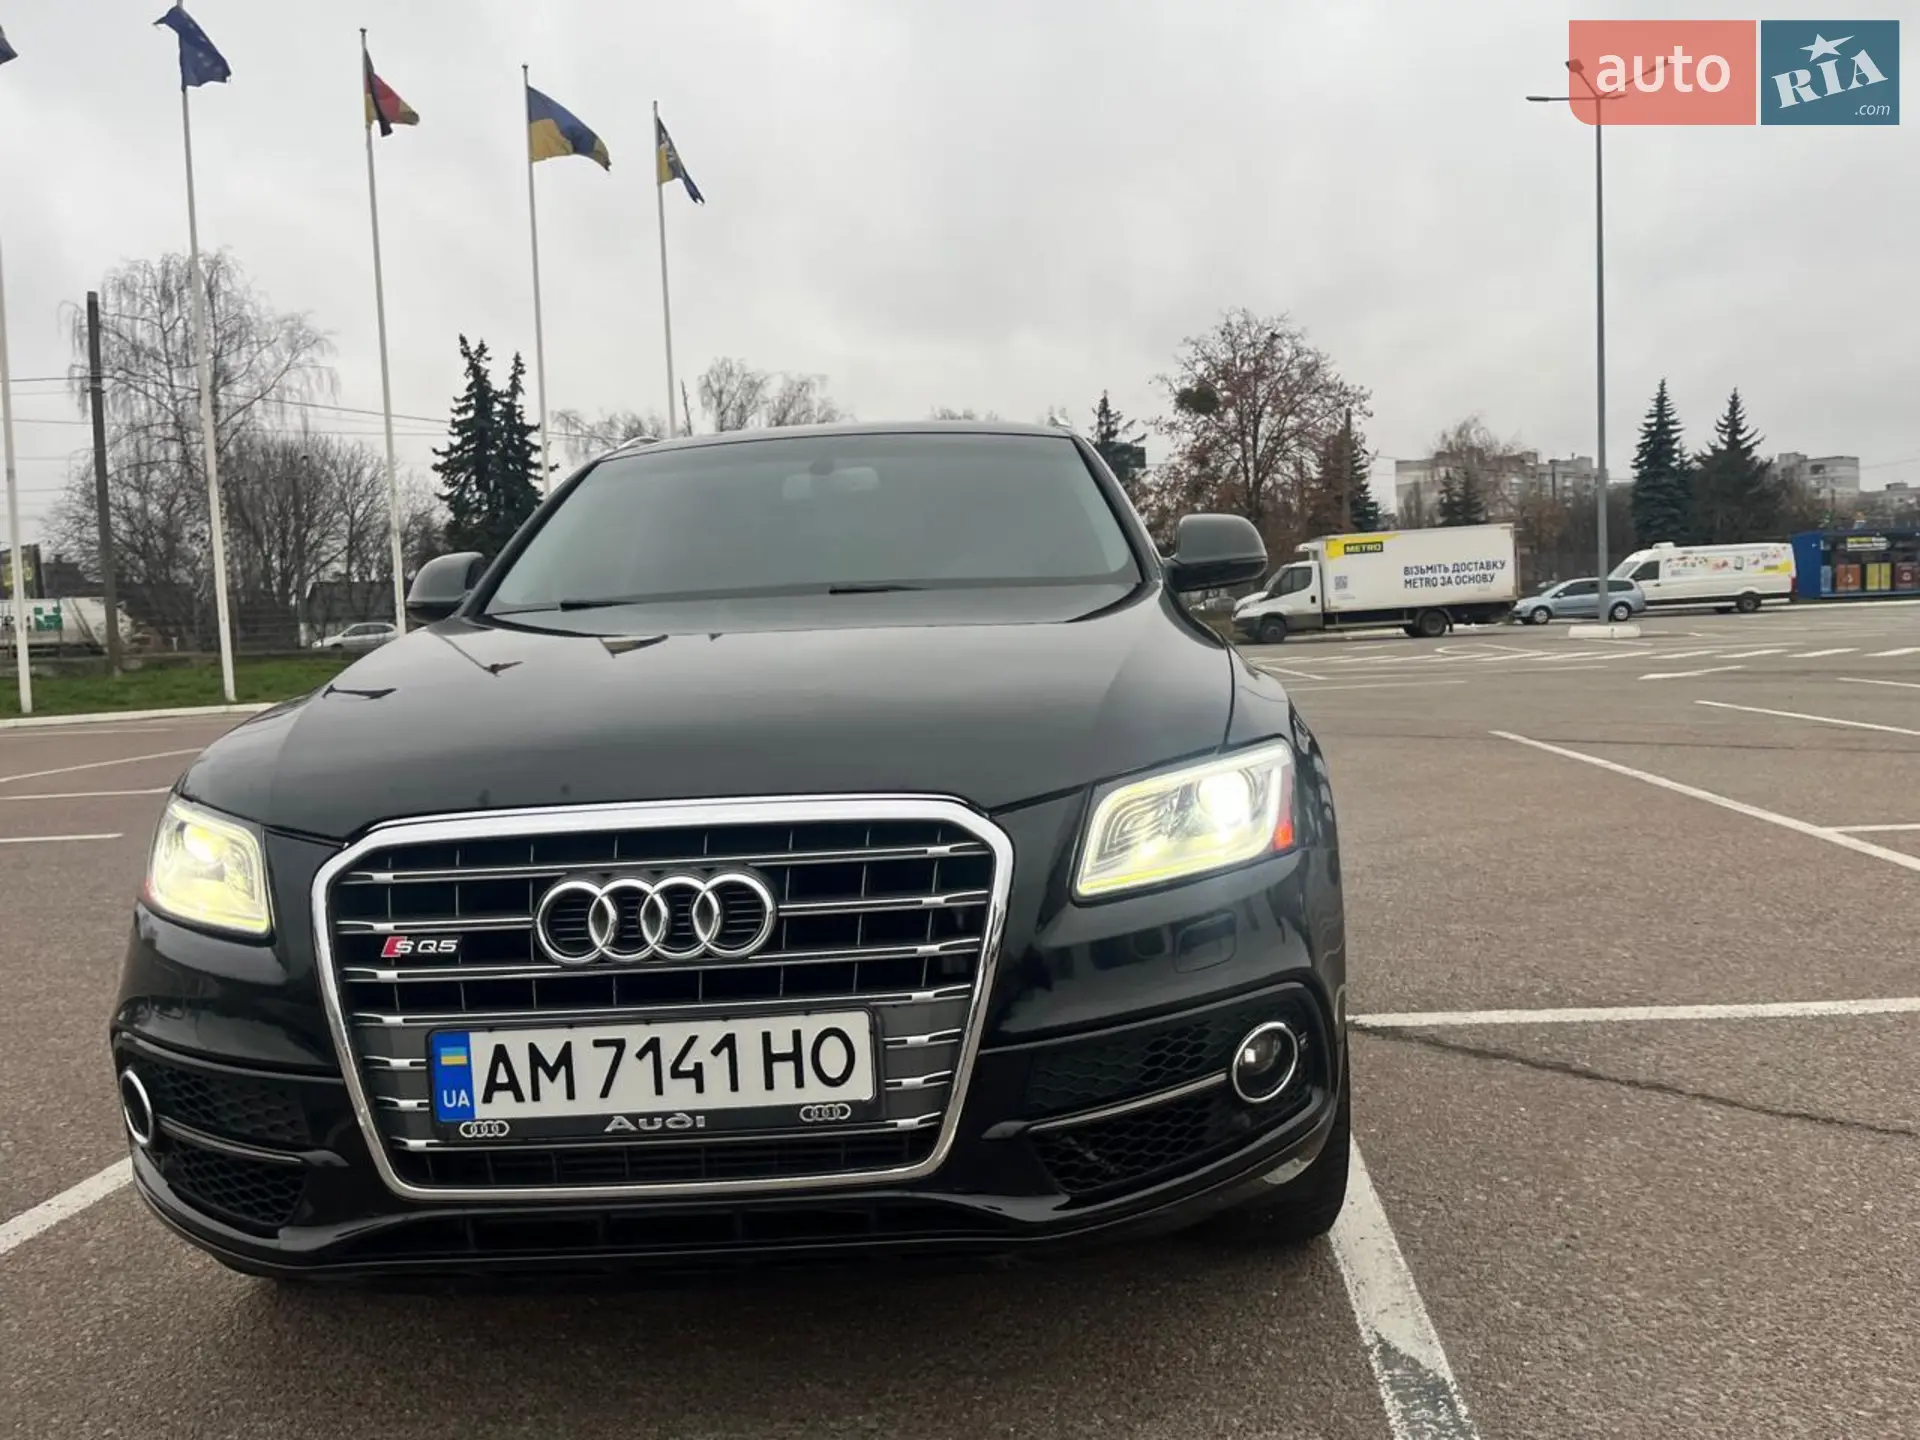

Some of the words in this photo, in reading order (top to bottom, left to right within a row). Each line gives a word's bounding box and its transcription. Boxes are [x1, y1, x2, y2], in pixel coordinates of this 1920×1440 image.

[1345, 543, 1382, 553] METRO
[1403, 564, 1450, 576] ВІЗЬМІТЬ
[1452, 560, 1506, 574] ДОСТАВКУ
[1439, 576, 1453, 587] ЗА
[1454, 573, 1496, 586] ОСНОВУ
[482, 1041, 576, 1104] AM
[592, 1033, 739, 1099] 7141
[761, 1027, 856, 1091] HO
[443, 1090, 471, 1108] UA
[604, 1112, 706, 1133] Audi
